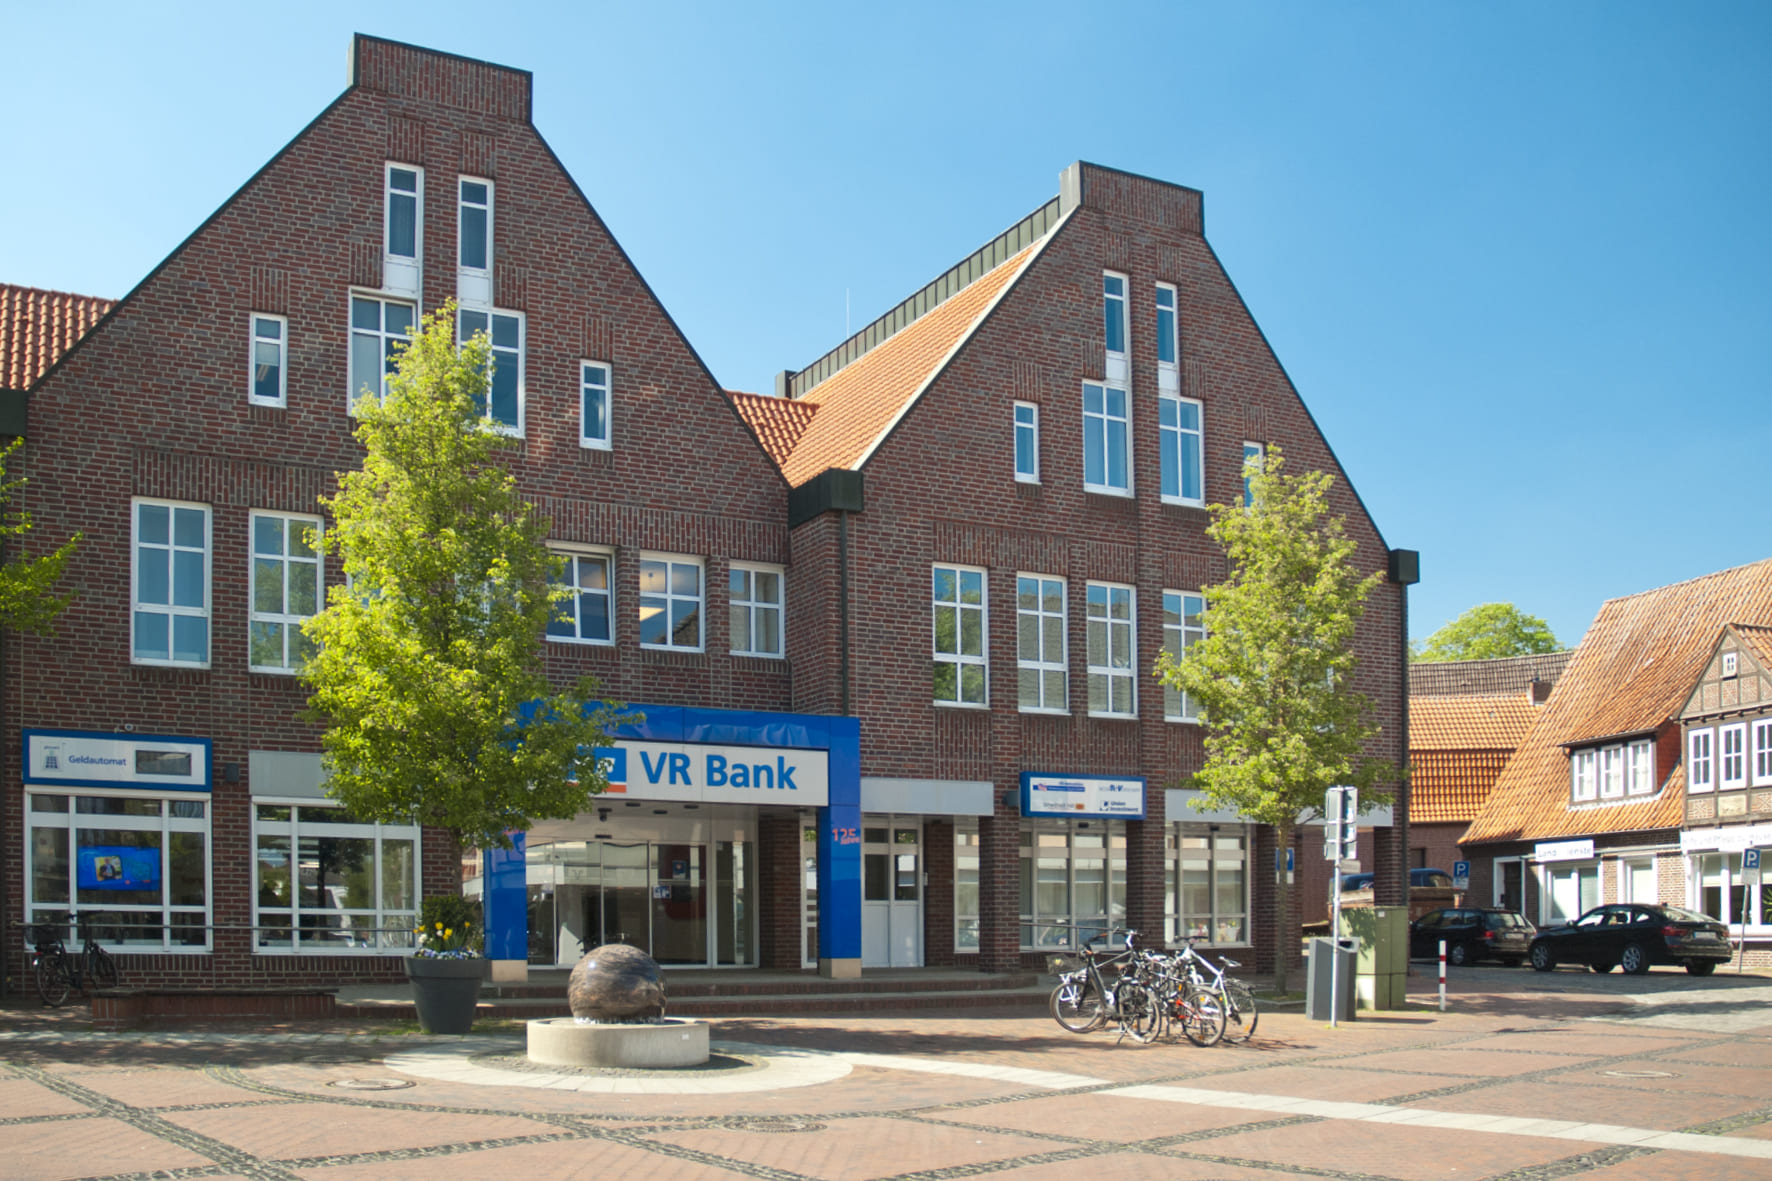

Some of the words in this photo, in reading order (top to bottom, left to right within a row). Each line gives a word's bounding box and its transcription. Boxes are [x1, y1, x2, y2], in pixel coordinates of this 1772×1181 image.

[68, 754, 126, 766] Geldautomat
[639, 751, 692, 785] VR
[706, 754, 798, 790] Bank
[1747, 851, 1757, 866] P
[1457, 864, 1466, 876] P
